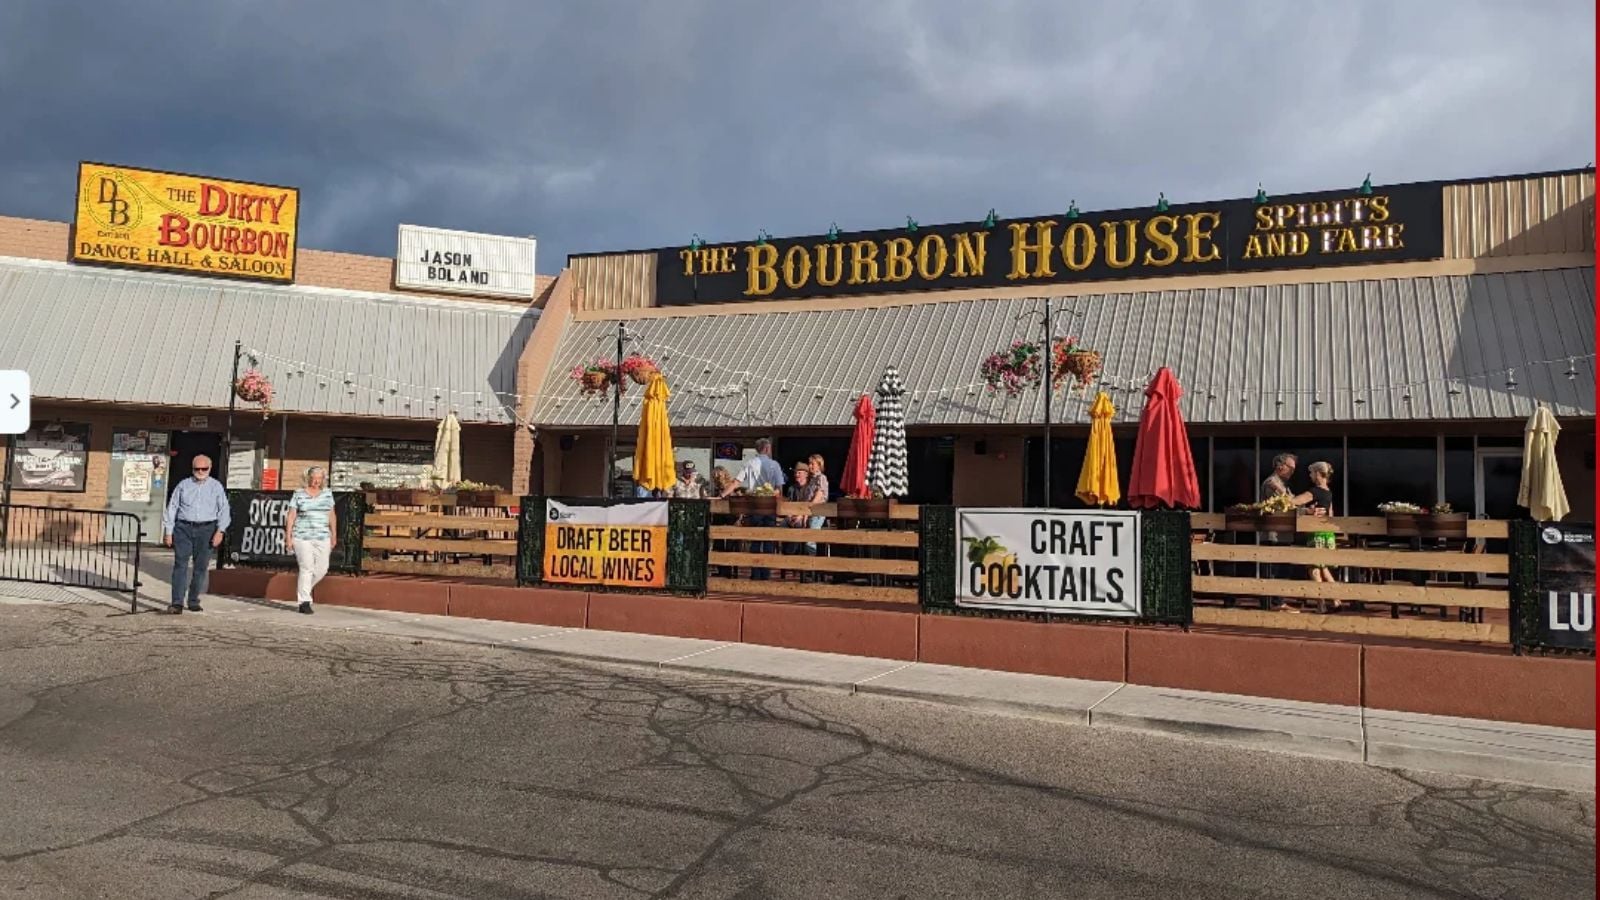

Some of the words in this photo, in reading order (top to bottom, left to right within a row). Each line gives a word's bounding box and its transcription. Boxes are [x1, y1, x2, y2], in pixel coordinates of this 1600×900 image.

[166, 187, 196, 203] THE
[197, 182, 288, 225] DIRTY
[1255, 196, 1390, 231] SPIRITS
[158, 213, 290, 259] BOURBON
[680, 246, 737, 276] THE
[742, 231, 990, 296] BOURBON
[1006, 211, 1222, 280] HOUSE
[1242, 231, 1310, 259] AND
[1320, 223, 1405, 254] FARE
[80, 242, 140, 260] DANCE
[147, 248, 194, 266] HALL
[200, 256, 214, 268] &
[218, 257, 286, 276] SALOON
[420, 250, 472, 266] JASON
[427, 266, 488, 285] BOLAND
[248, 498, 291, 526] OVER
[556, 526, 605, 551] DRAFT
[608, 528, 652, 552] BEER
[1030, 519, 1124, 557] CRAFT
[550, 554, 598, 579] LOCAL
[602, 556, 656, 582] WINES
[969, 562, 1124, 603] COCKTAILS
